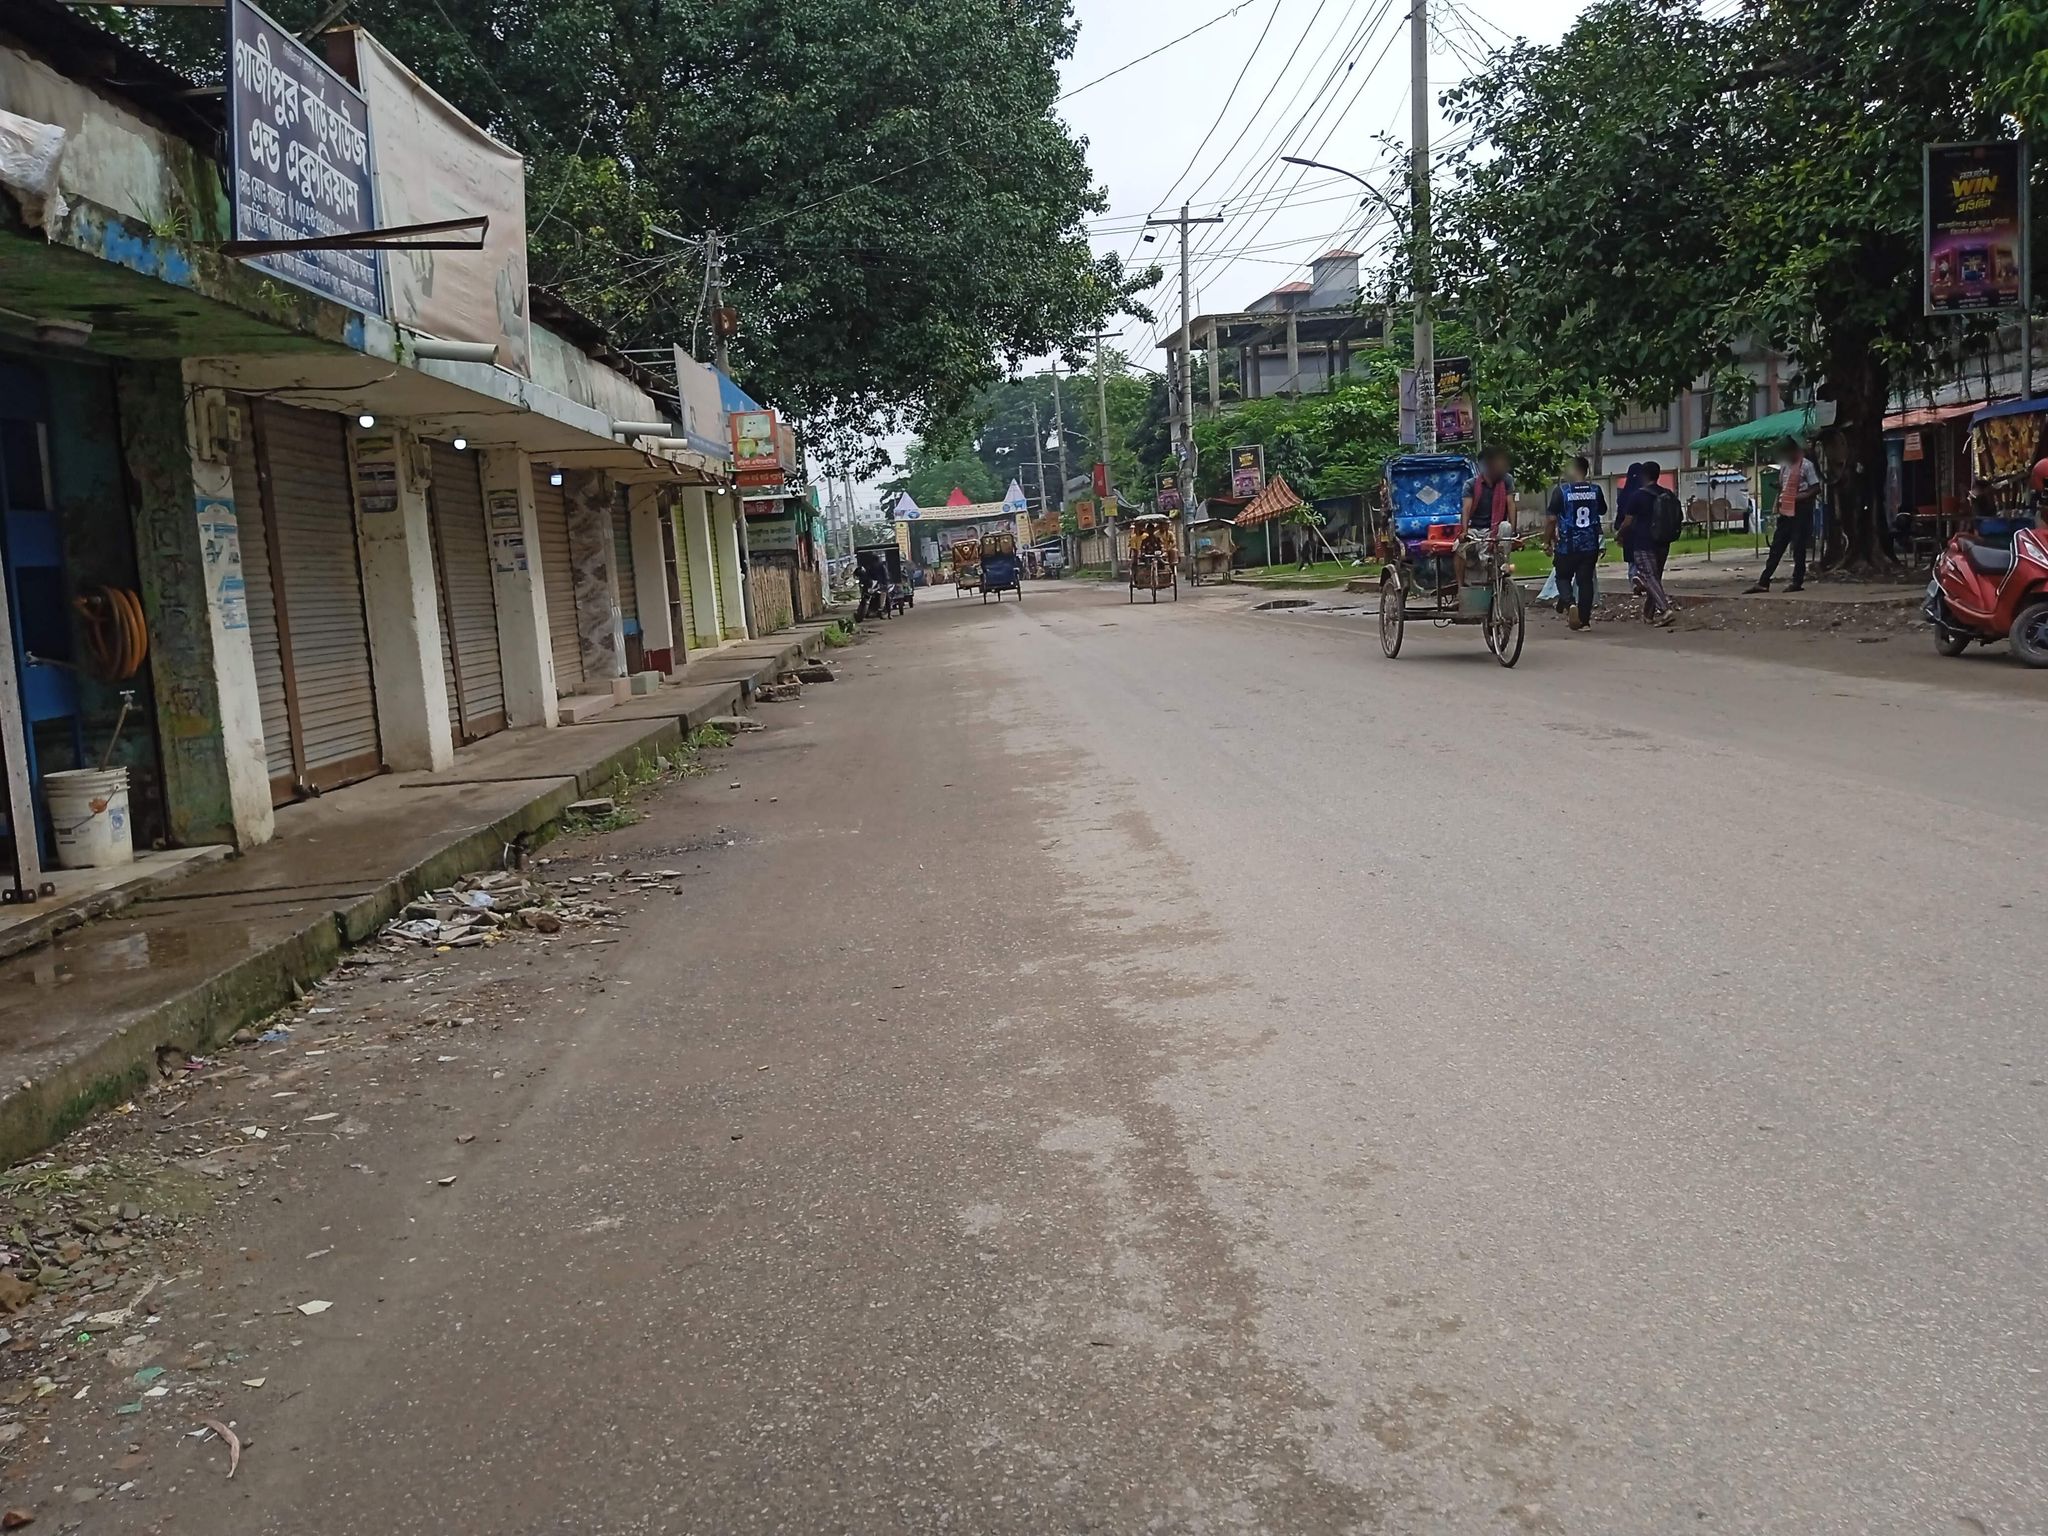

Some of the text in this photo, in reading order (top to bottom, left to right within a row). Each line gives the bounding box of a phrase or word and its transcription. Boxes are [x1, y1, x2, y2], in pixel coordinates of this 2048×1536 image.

[235, 32, 300, 129] গাজীপুর
[249, 118, 280, 174] এন্ড
[1952, 175, 1998, 198] WIN
[1576, 506, 1590, 528] 8
